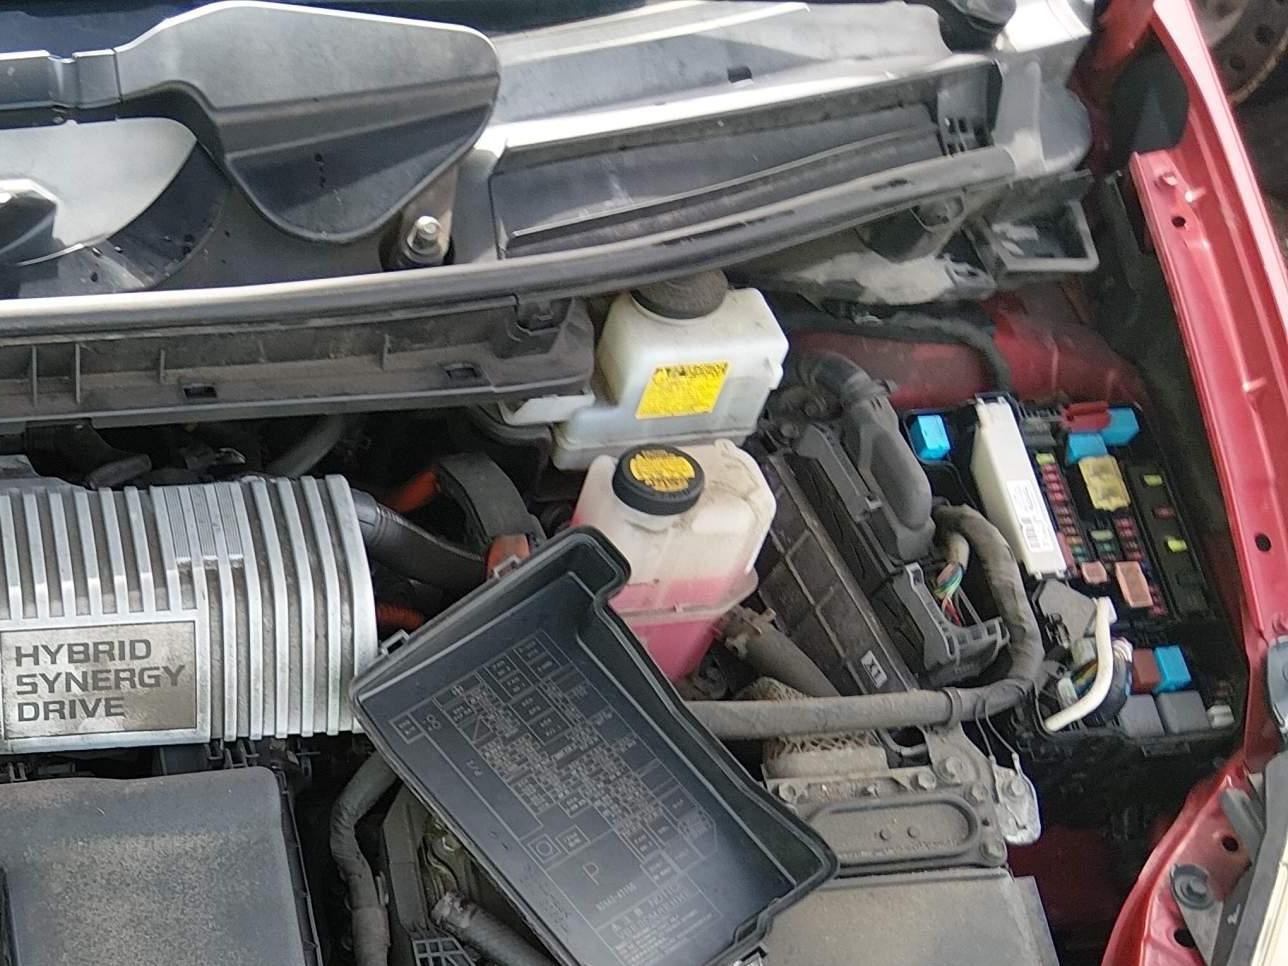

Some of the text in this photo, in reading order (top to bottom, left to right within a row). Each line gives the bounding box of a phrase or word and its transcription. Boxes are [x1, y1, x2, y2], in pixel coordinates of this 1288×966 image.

[15, 639, 151, 667] HYBRID
[16, 665, 185, 695] SYNERGY
[17, 696, 125, 722] DRIVE
